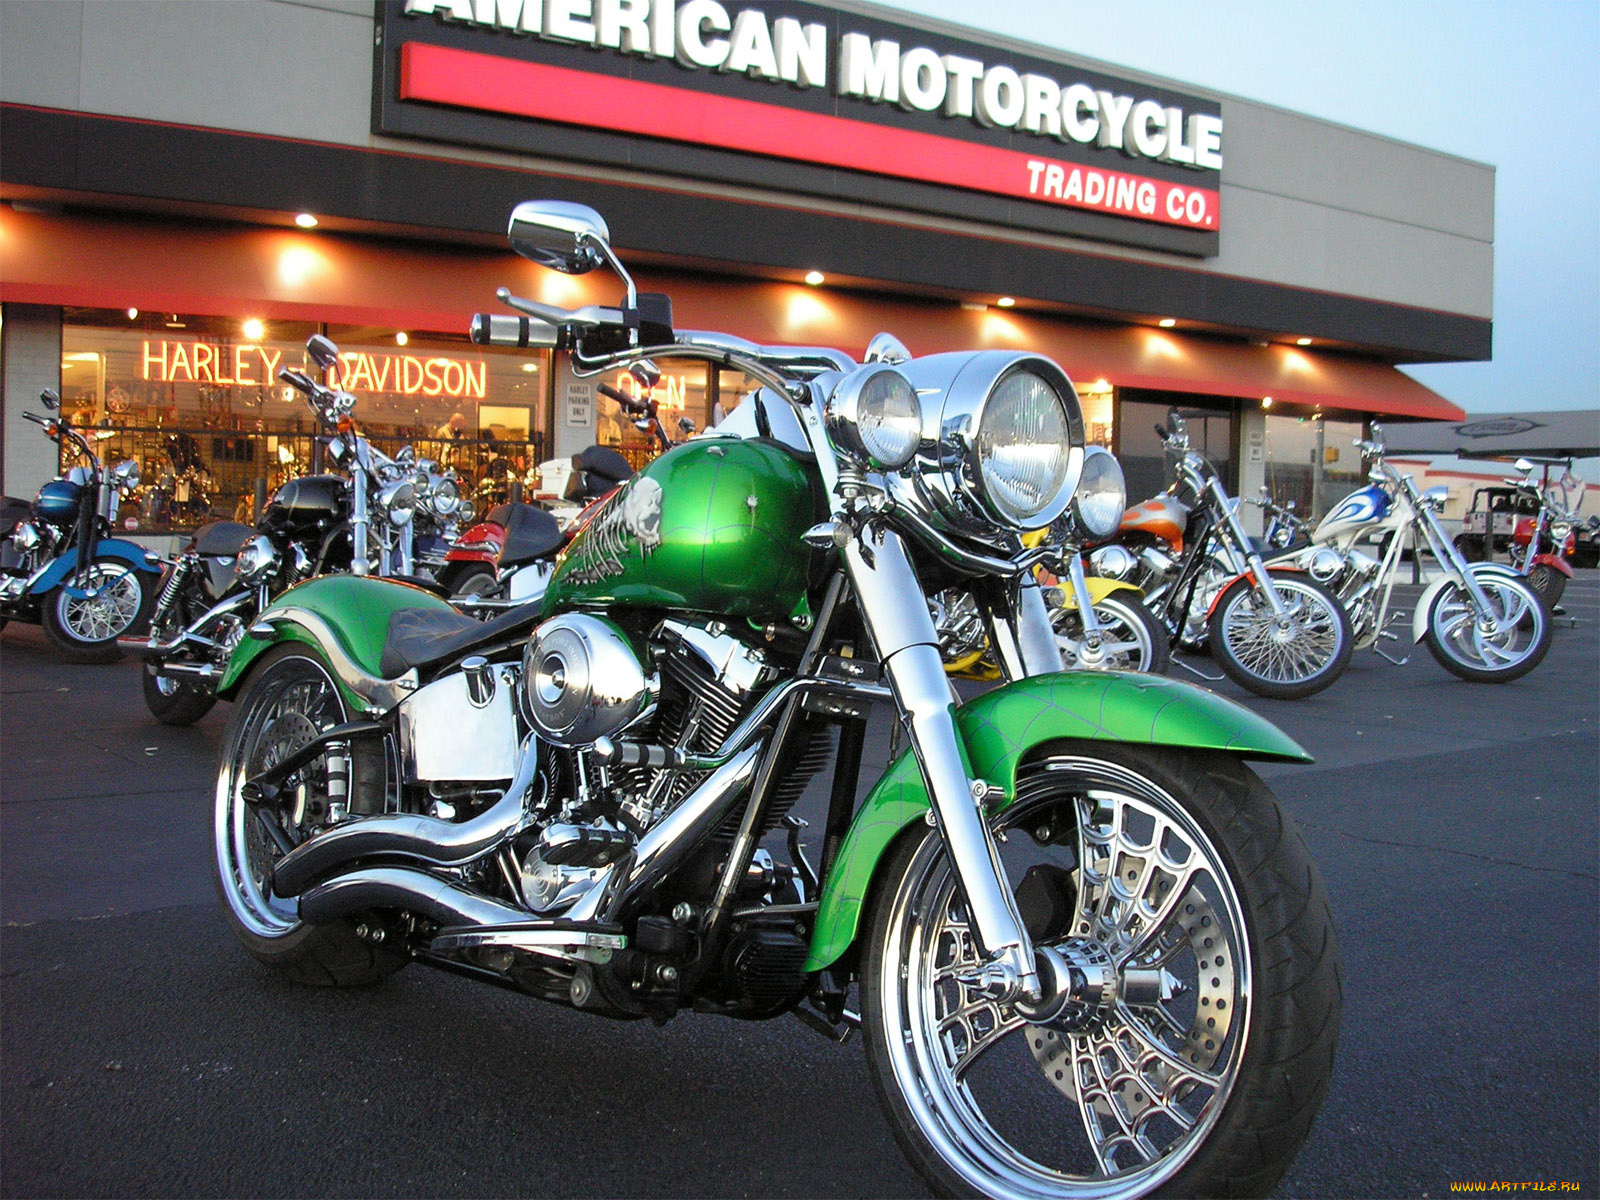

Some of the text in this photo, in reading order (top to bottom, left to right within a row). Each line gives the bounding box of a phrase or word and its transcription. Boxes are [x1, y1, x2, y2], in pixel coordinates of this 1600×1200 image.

[403, 0, 1223, 171] ERICAN MOTORCYCLE
[1027, 160, 1213, 226] TRADING CO.
[328, 352, 488, 399] DAVIDSON
[568, 395, 590, 405] PARKING
[573, 407, 585, 416] ONLY
